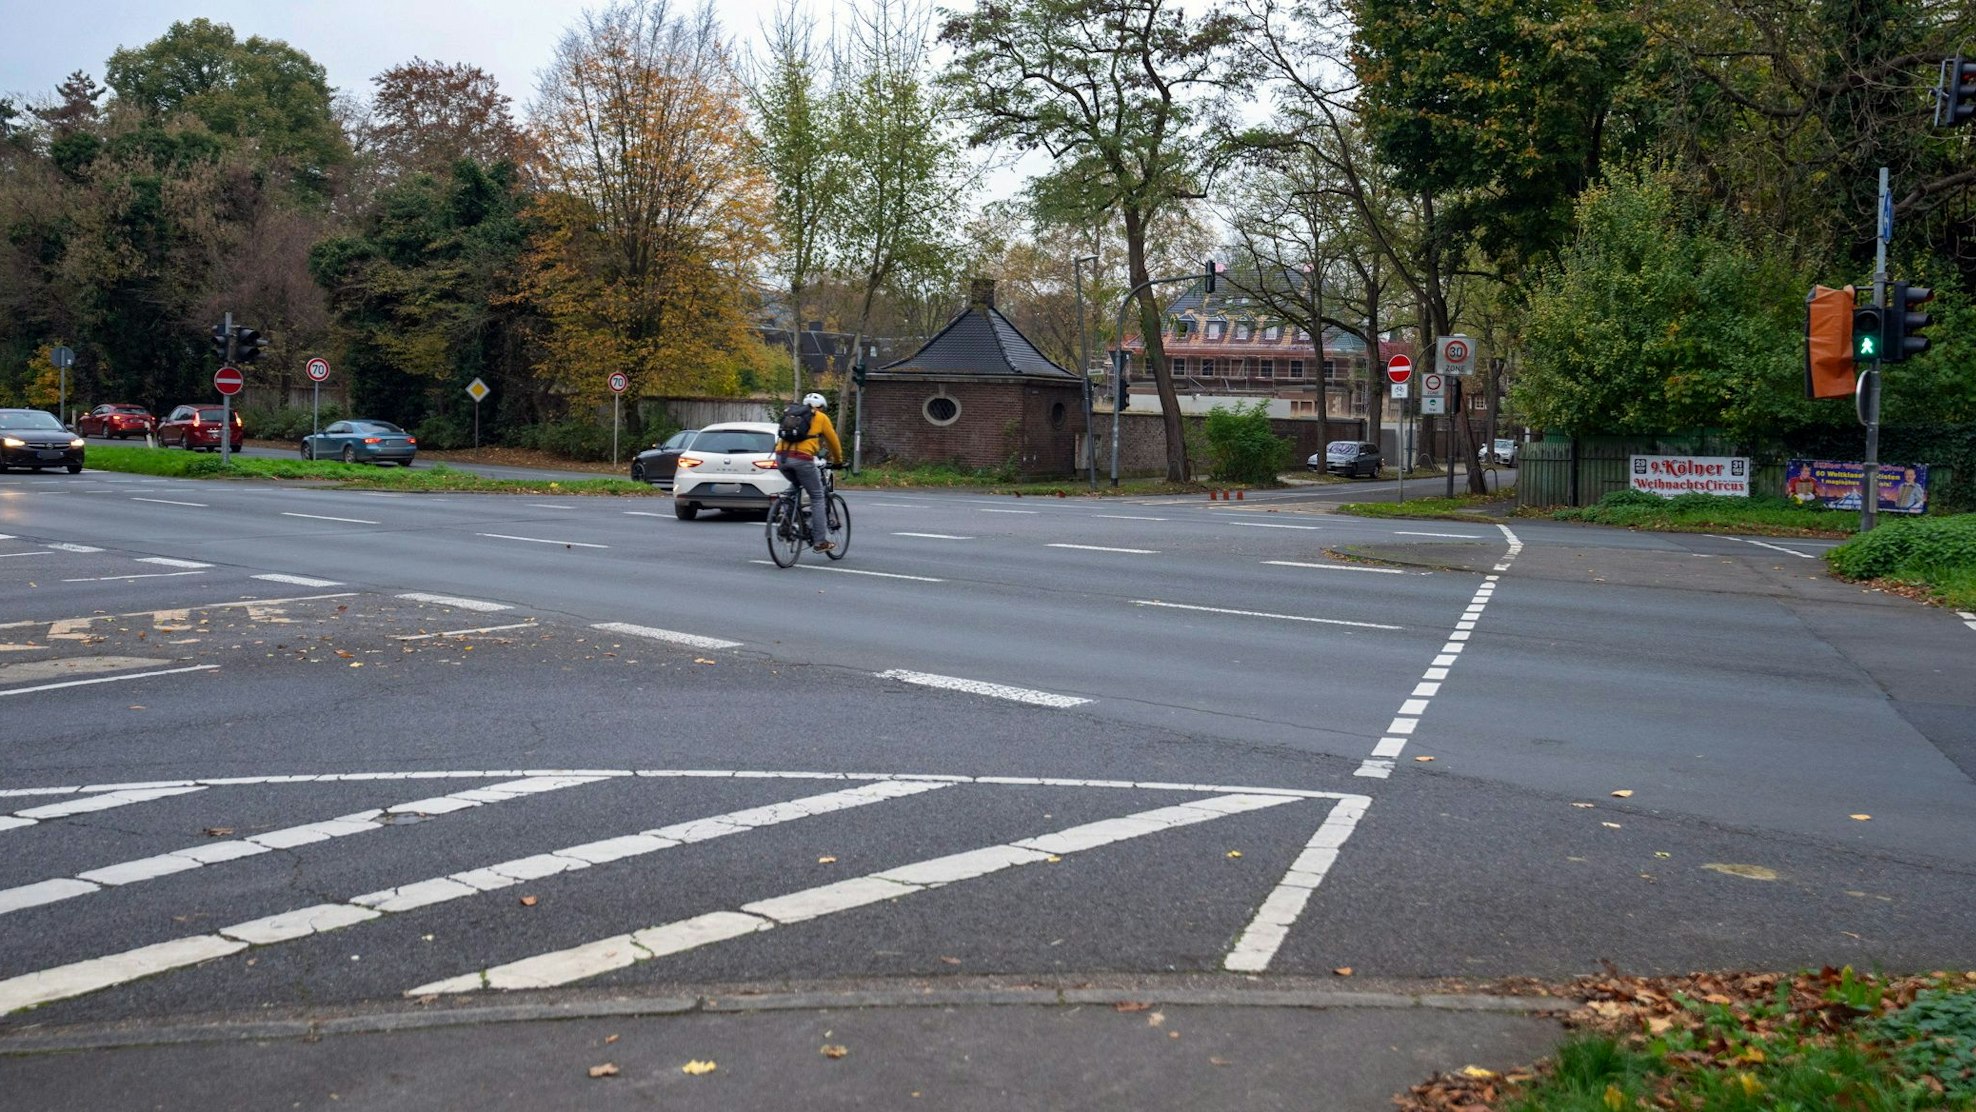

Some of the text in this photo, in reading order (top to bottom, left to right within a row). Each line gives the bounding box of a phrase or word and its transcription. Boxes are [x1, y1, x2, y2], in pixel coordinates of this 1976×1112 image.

[1449, 346, 1463, 358] 30
[312, 364, 325, 375] 70
[1445, 364, 1466, 372] ZONE
[613, 377, 624, 387] 70
